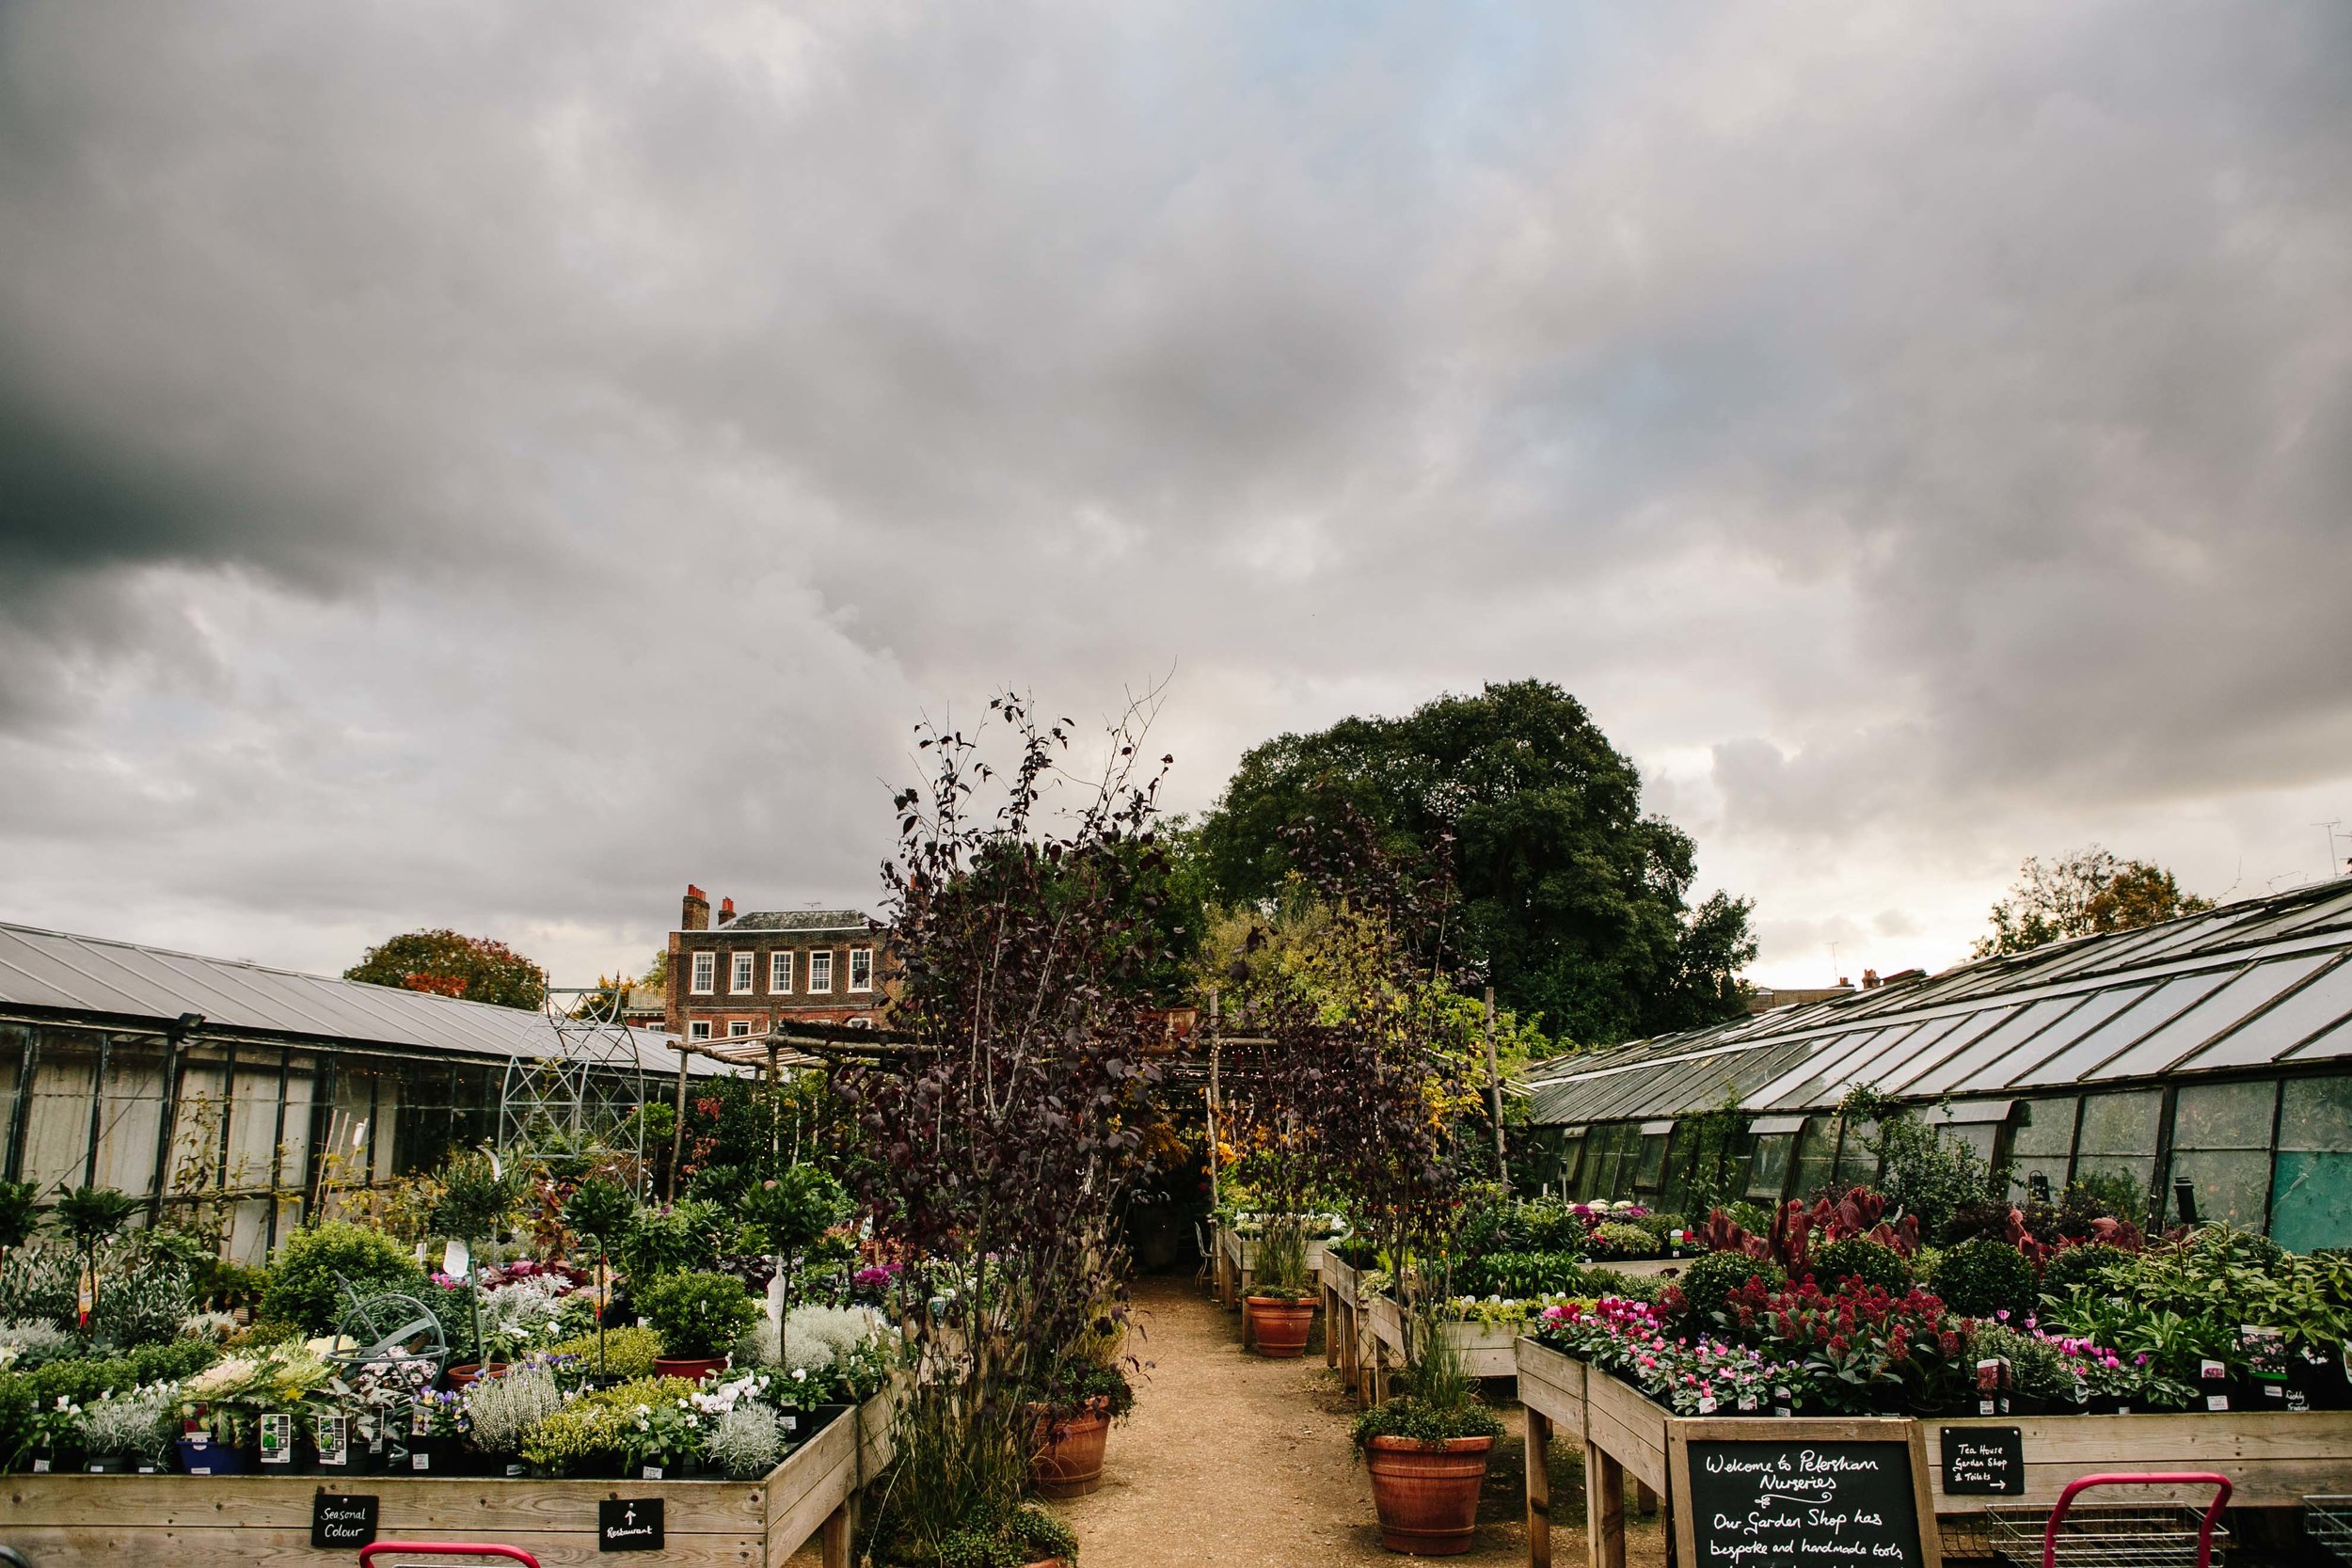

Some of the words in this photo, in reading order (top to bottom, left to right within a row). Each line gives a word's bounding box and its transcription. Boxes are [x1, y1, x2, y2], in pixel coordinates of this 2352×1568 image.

[1958, 1443, 1978, 1455] Tea
[1979, 1444, 2003, 1456] House
[1706, 1453, 1774, 1474] Welcome
[1777, 1453, 1792, 1472] to
[1799, 1449, 1879, 1474] Petersham
[1951, 1457, 1984, 1472] Garden
[1987, 1457, 2008, 1471] Shop
[1759, 1474, 1837, 1492] Nurseries
[1963, 1472, 1991, 1481] Toilets
[320, 1507, 366, 1521] Seasonal
[1713, 1513, 1742, 1530] Our
[1743, 1509, 1802, 1536] Garden
[1807, 1506, 1848, 1535] Shop
[1853, 1506, 1883, 1526] has
[325, 1523, 364, 1538] Colour
[607, 1525, 653, 1539] Restaurant
[1709, 1539, 1768, 1565] bespoke
[1772, 1539, 1794, 1554] and
[1801, 1538, 1867, 1555] handmade
